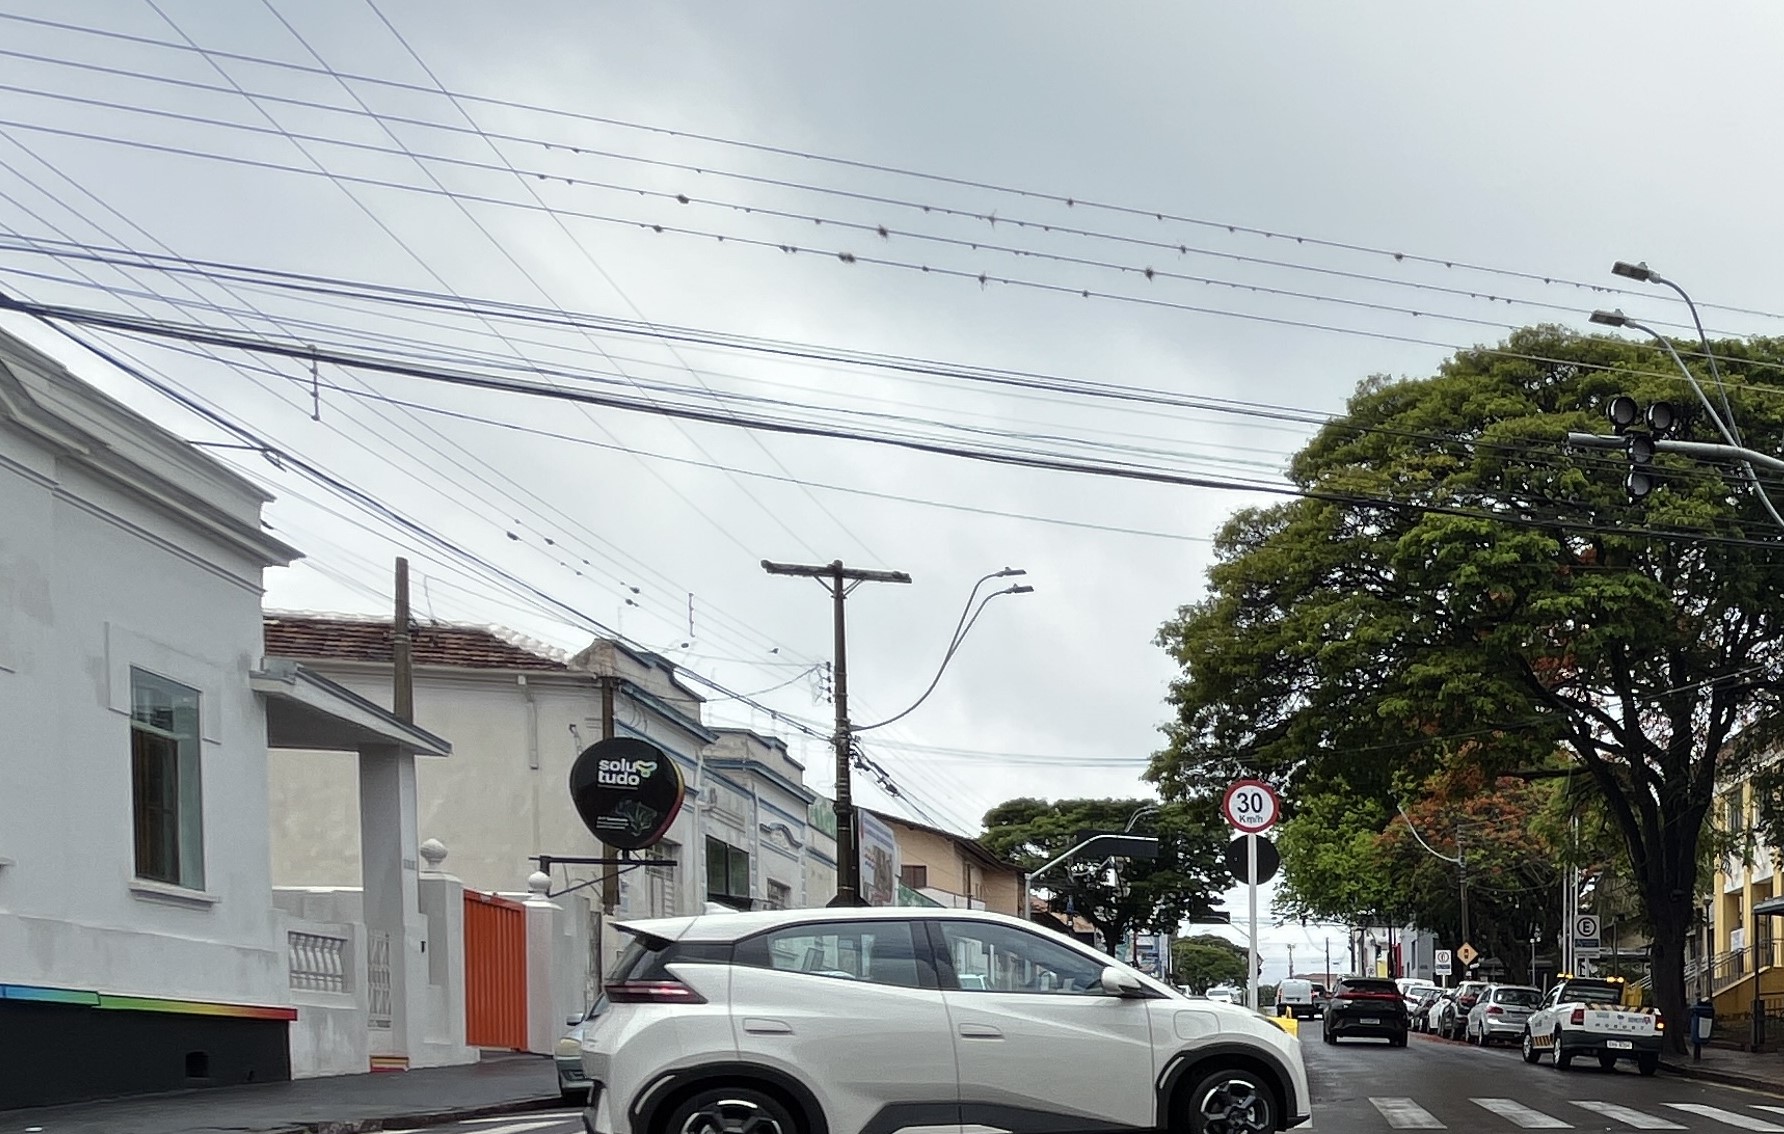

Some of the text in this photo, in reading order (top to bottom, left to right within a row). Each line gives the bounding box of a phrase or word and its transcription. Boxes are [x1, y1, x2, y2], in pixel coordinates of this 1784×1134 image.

[599, 758, 637, 773] solu
[598, 771, 640, 785] tudo
[1237, 792, 1263, 814] 30
[1583, 921, 1591, 933] E
